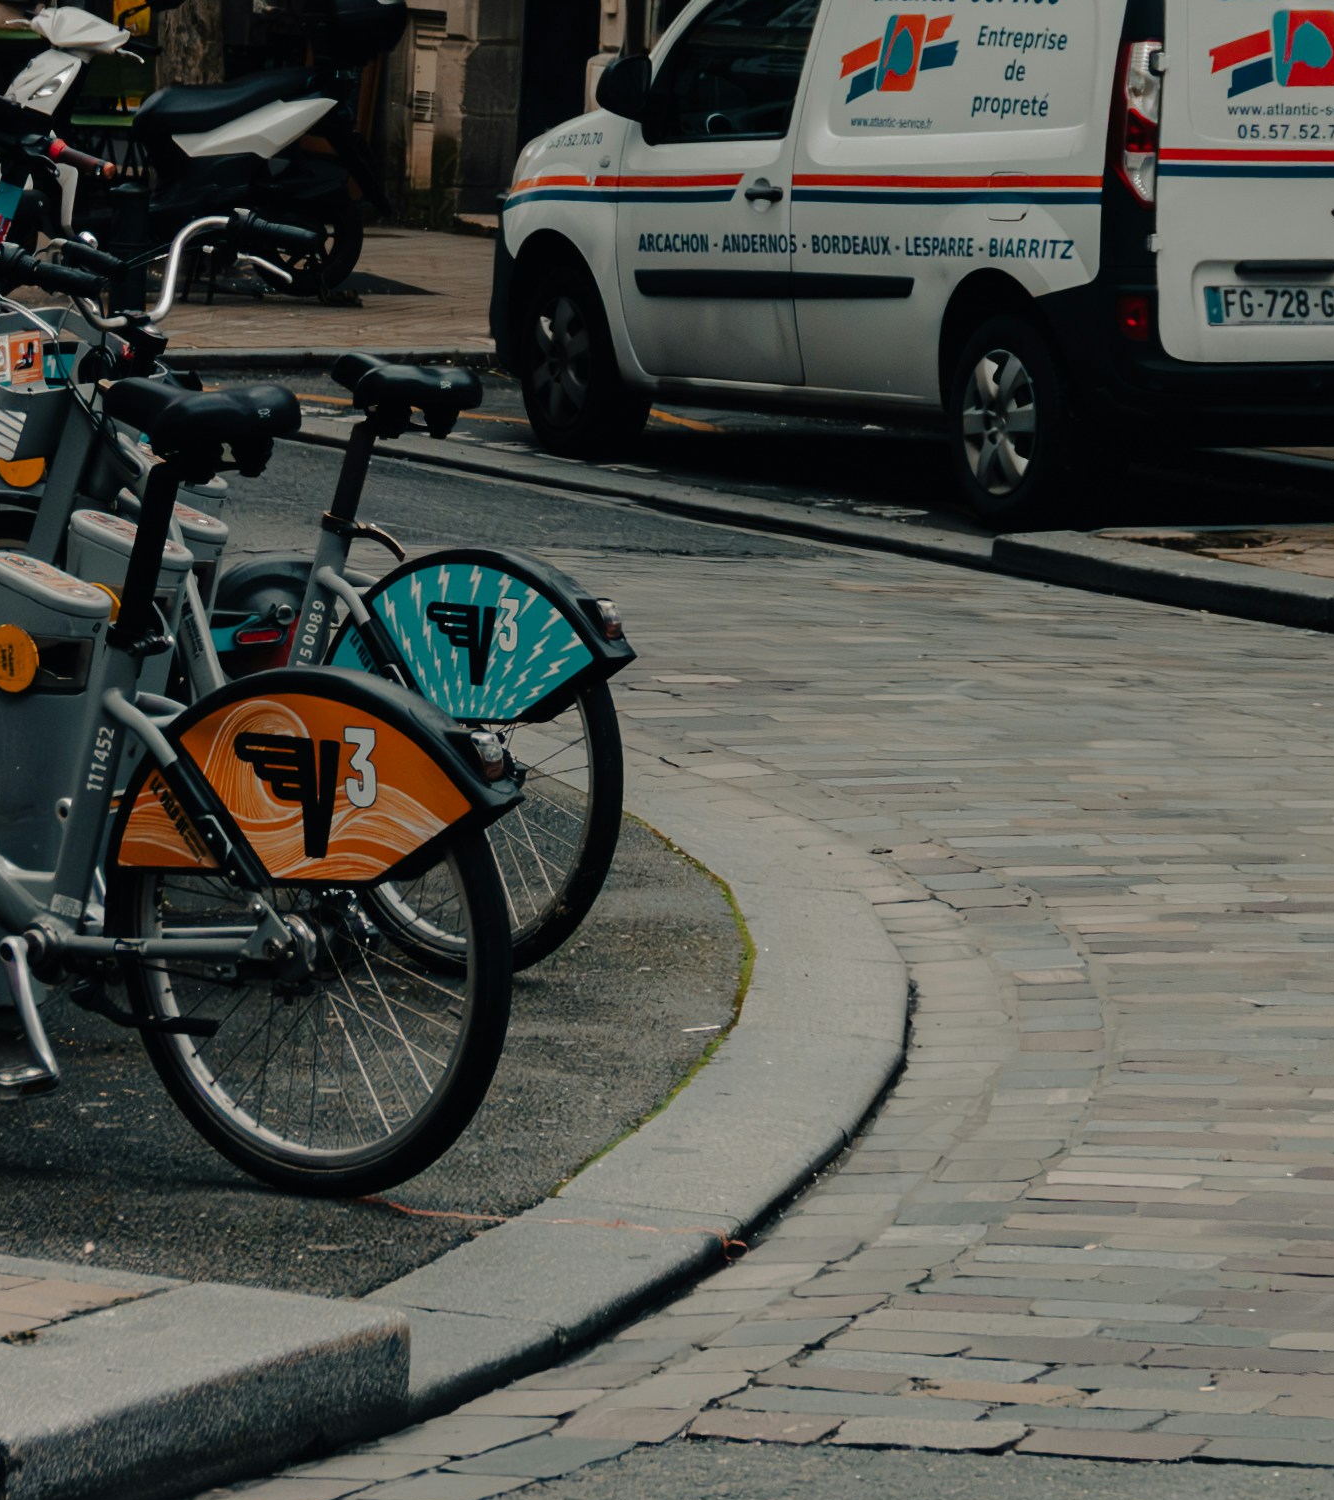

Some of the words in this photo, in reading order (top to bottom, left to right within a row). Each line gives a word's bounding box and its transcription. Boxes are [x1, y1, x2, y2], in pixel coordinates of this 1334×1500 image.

[977, 25, 1068, 54] Entreprise
[1004, 59, 1026, 81] de
[971, 93, 1049, 119] propreté
[850, 116, 933, 130] www.atlantic-service.fr
[638, 233, 709, 253] ARCACHON
[722, 234, 797, 254] ANDERNOS
[811, 235, 891, 256] BORDEAUX
[905, 237, 974, 258] LESPARRE
[989, 238, 1075, 260] BIARRITZ
[87, 726, 115, 791] 111452
